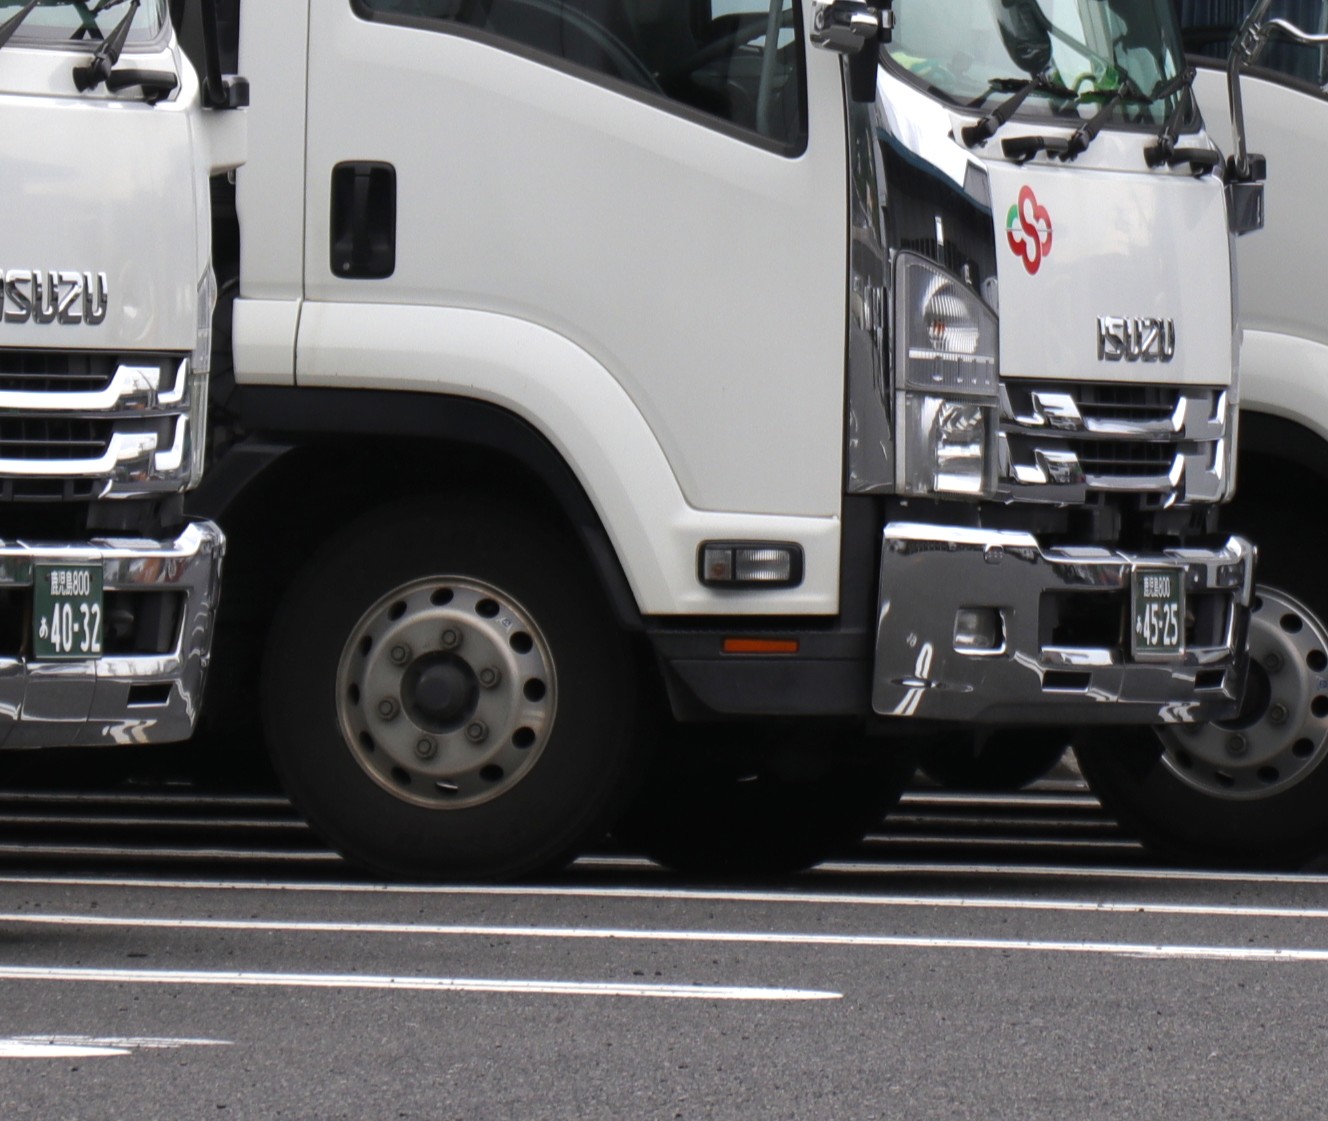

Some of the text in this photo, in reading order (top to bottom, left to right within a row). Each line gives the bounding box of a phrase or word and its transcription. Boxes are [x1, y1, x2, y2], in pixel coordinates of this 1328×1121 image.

[1096, 314, 1176, 363] ISUZU
[51, 570, 90, 596] 鹿児島800
[50, 602, 101, 653] 40-32
